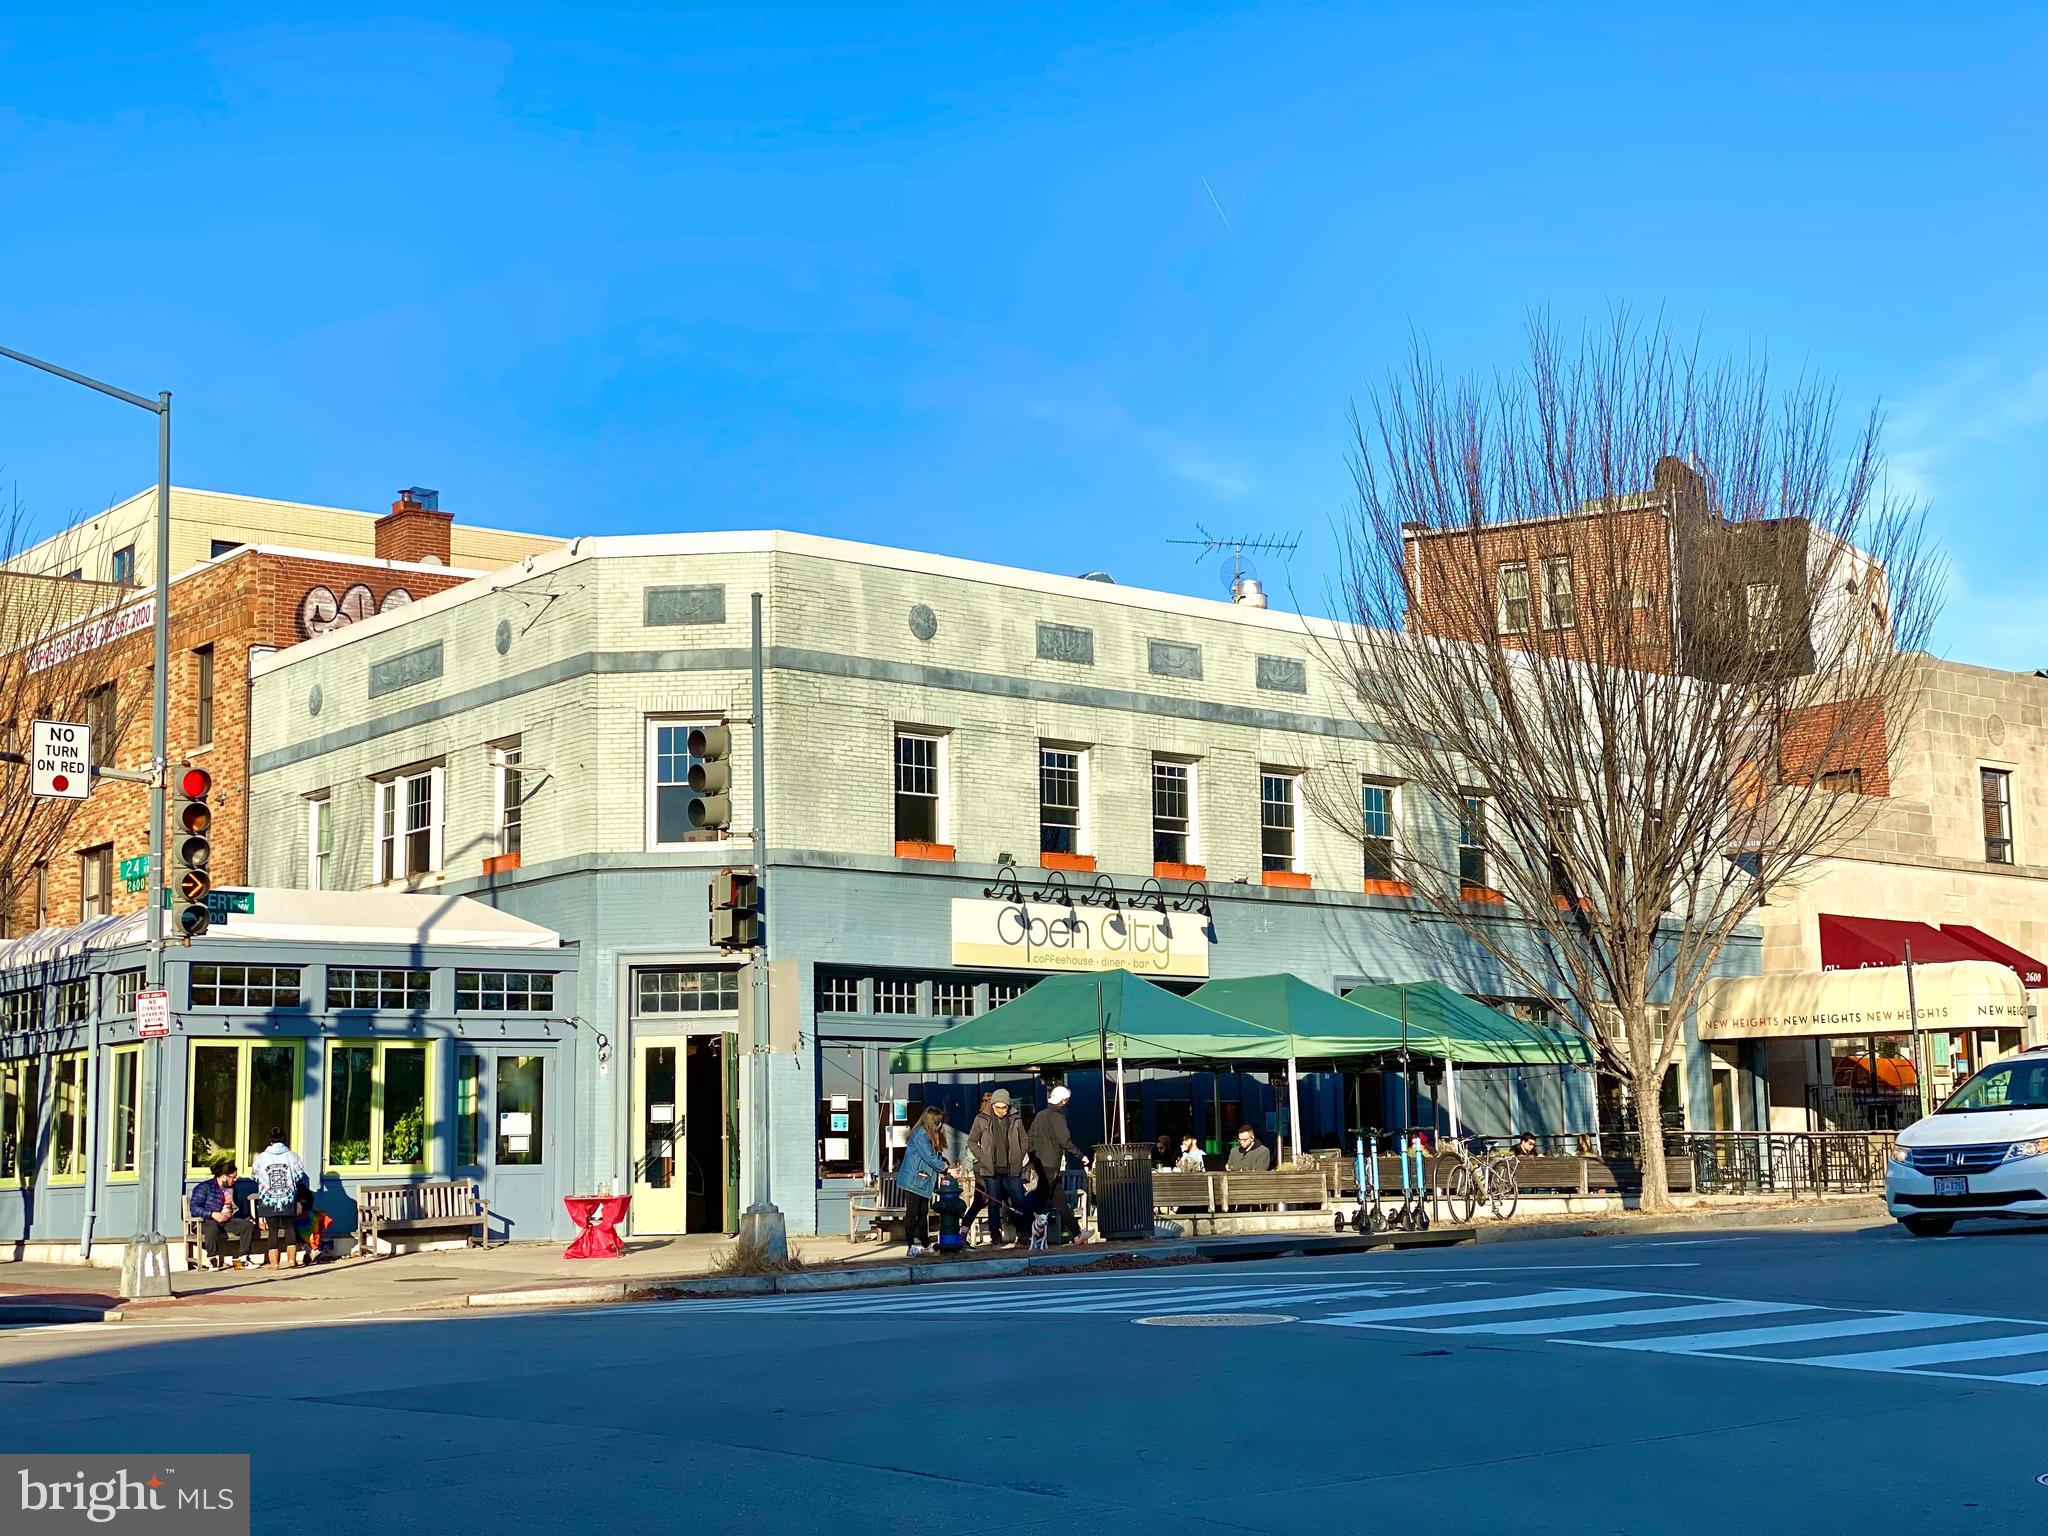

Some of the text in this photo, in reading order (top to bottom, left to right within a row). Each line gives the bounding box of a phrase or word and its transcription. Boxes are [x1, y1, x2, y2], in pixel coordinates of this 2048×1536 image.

[50, 727, 74, 742] NO
[45, 745, 78, 758] TURN
[37, 759, 85, 774] ON RED
[126, 859, 140, 877] 24
[128, 878, 145, 892] 2600
[997, 906, 1169, 970] Open City
[1033, 954, 1150, 969] coffeehouse diner bar
[2025, 972, 2042, 983] 2600
[1978, 1005, 2004, 1016] NEW
[1705, 1007, 1948, 1030] NEW HEIGHTS NEW HEIGHTS NEW HEGHTS
